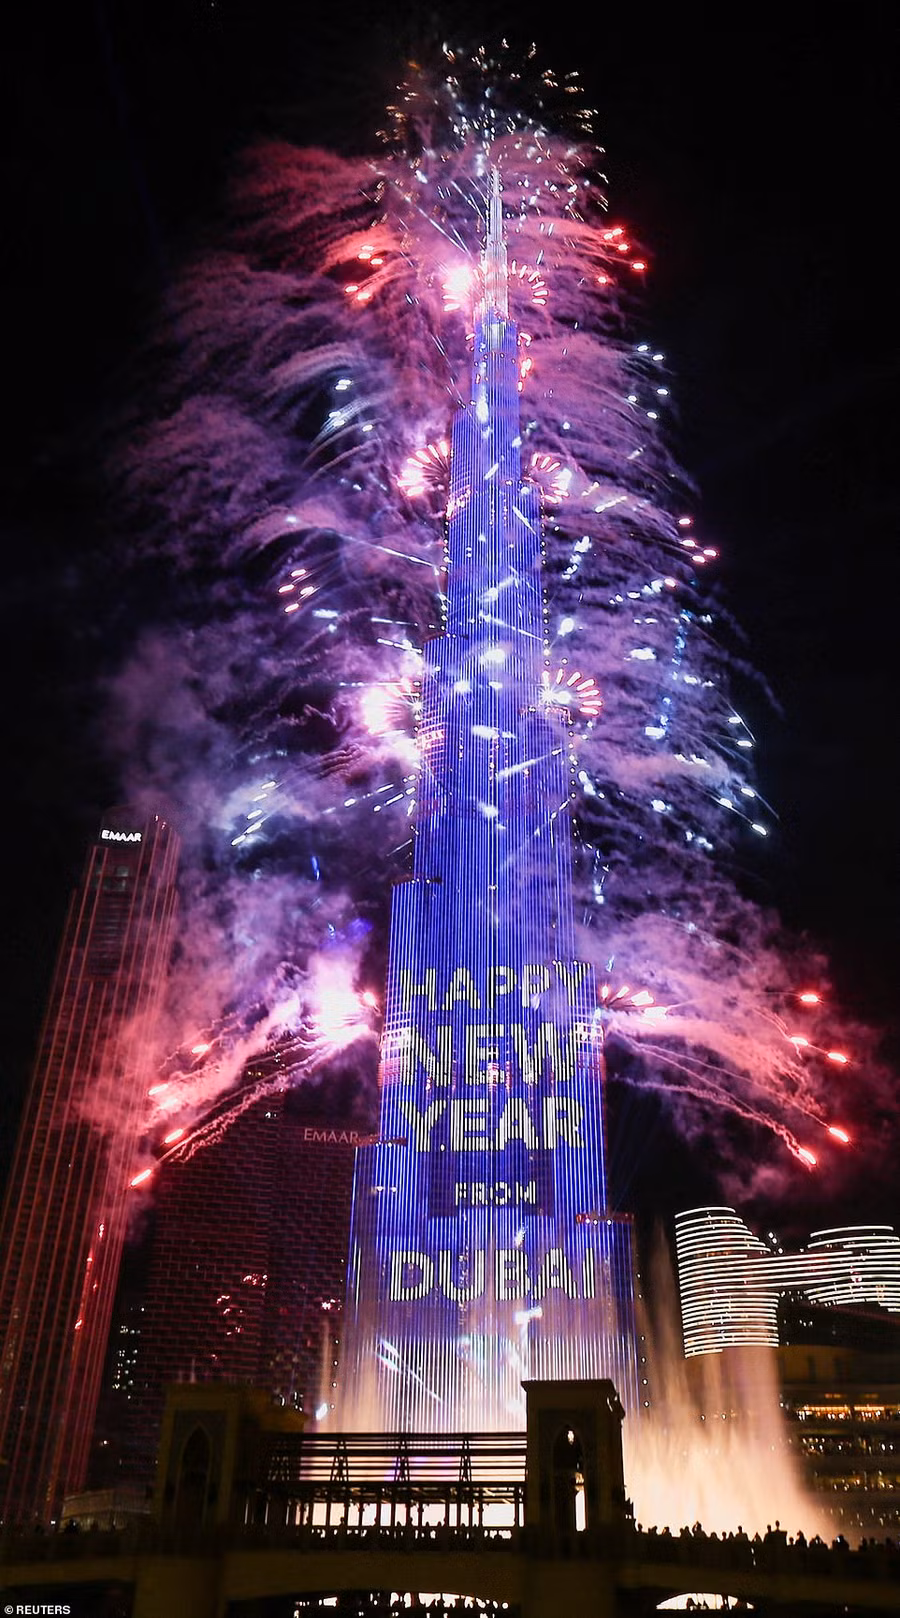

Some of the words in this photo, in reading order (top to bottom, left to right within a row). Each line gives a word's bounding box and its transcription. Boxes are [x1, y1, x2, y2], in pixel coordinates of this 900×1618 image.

[101, 829, 142, 842] EMAAR
[399, 963, 591, 1011] HAPPY
[400, 1023, 584, 1087] NEW
[303, 1128, 359, 1144] EMAAR
[399, 1097, 585, 1152] YEAR
[455, 1181, 537, 1206] FROM
[390, 1248, 596, 1301] DUBAI
